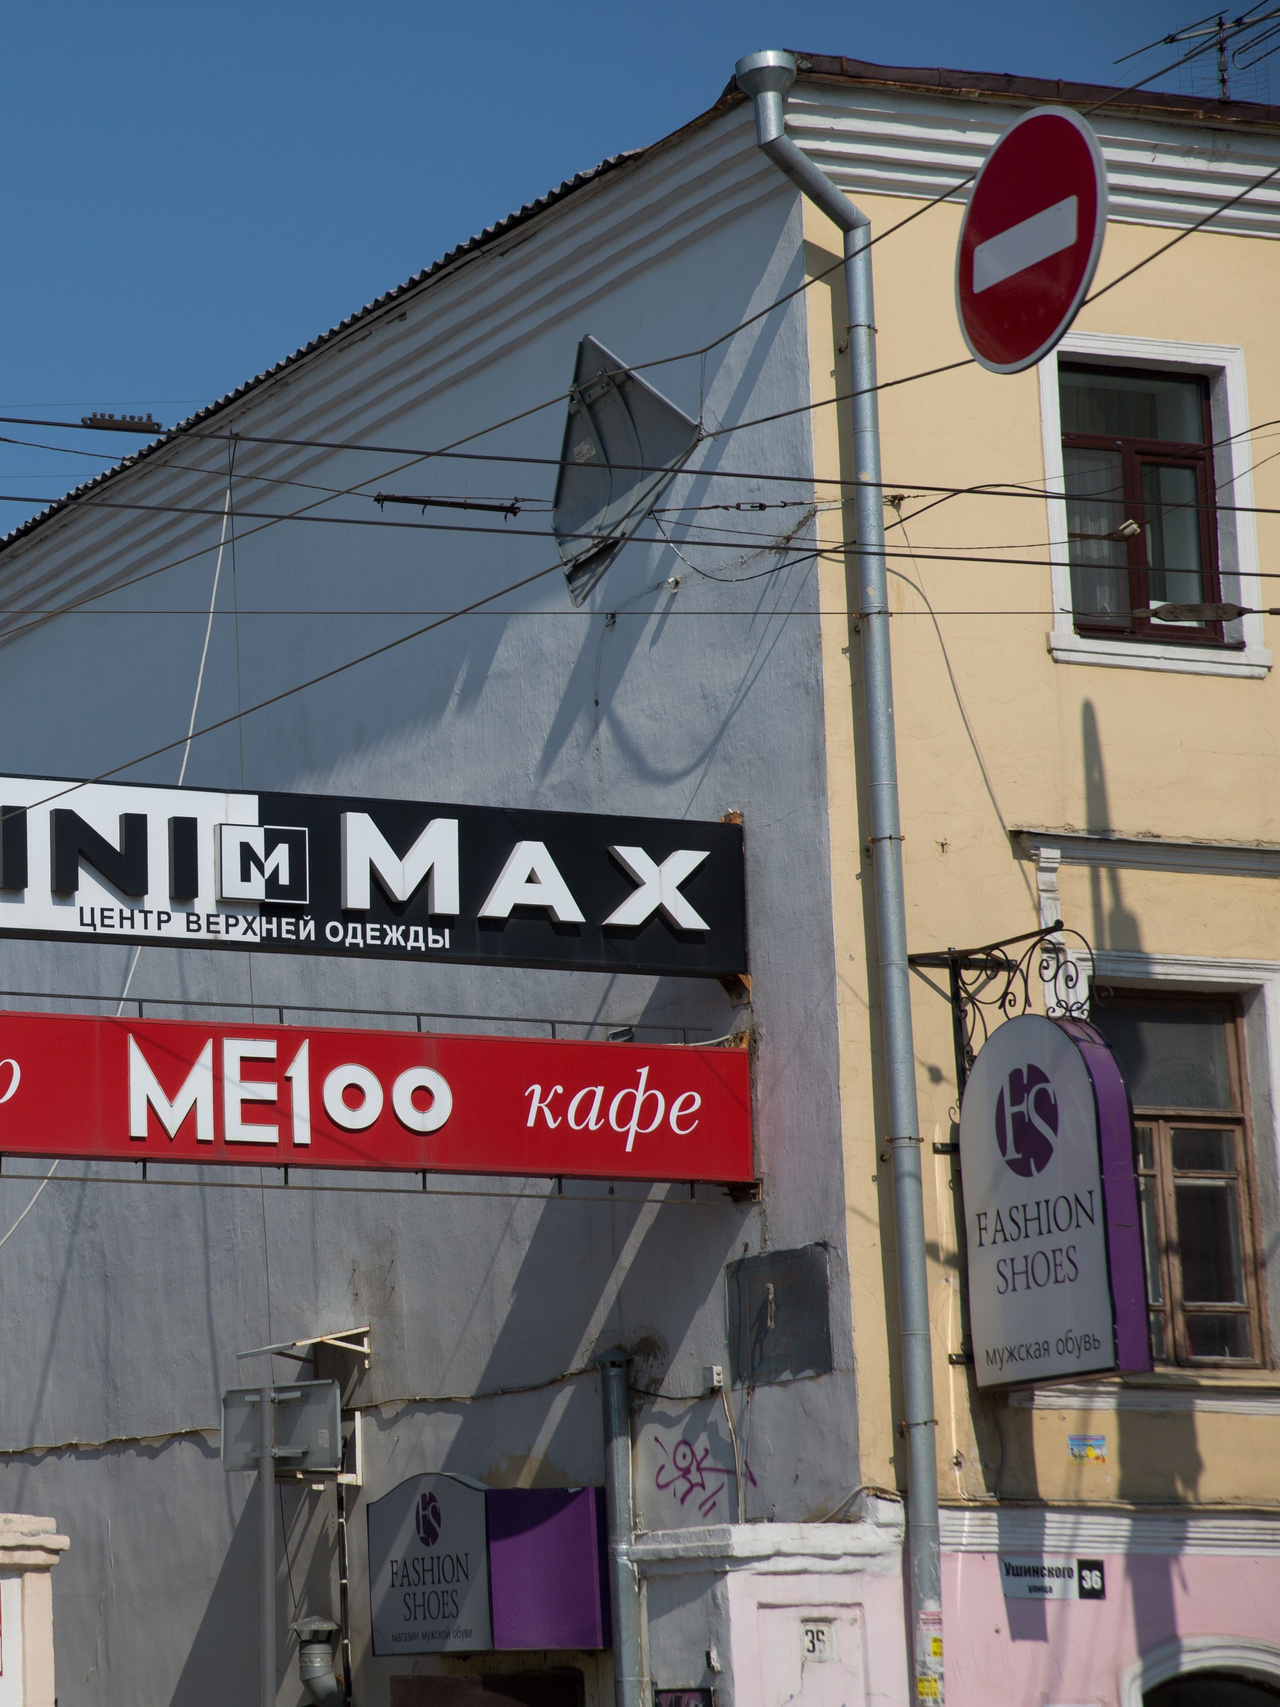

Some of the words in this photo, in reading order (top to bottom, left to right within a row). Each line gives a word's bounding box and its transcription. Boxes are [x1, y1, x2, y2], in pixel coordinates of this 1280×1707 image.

[339, 811, 712, 931] MAX
[78, 905, 173, 932] ЦЕНТР
[185, 912, 317, 941] ВЕРХНЕЙ
[324, 920, 451, 951] ОДЕЖДЫ
[523, 1064, 703, 1153] кафе
[975, 1188, 1096, 1249] FASHION
[995, 1245, 1080, 1296] SHOES
[984, 1335, 1051, 1371] мужская
[1055, 1329, 1101, 1364] обувь
[389, 1552, 470, 1589] FASHION
[1004, 1561, 1075, 1580] Ушинского
[1080, 1569, 1103, 1590] 36
[1027, 1584, 1053, 1594] улица
[402, 1589, 459, 1622] SHOES
[391, 1631, 420, 1643] магазин
[421, 1626, 451, 1644] мужской
[452, 1625, 473, 1642] обуви
